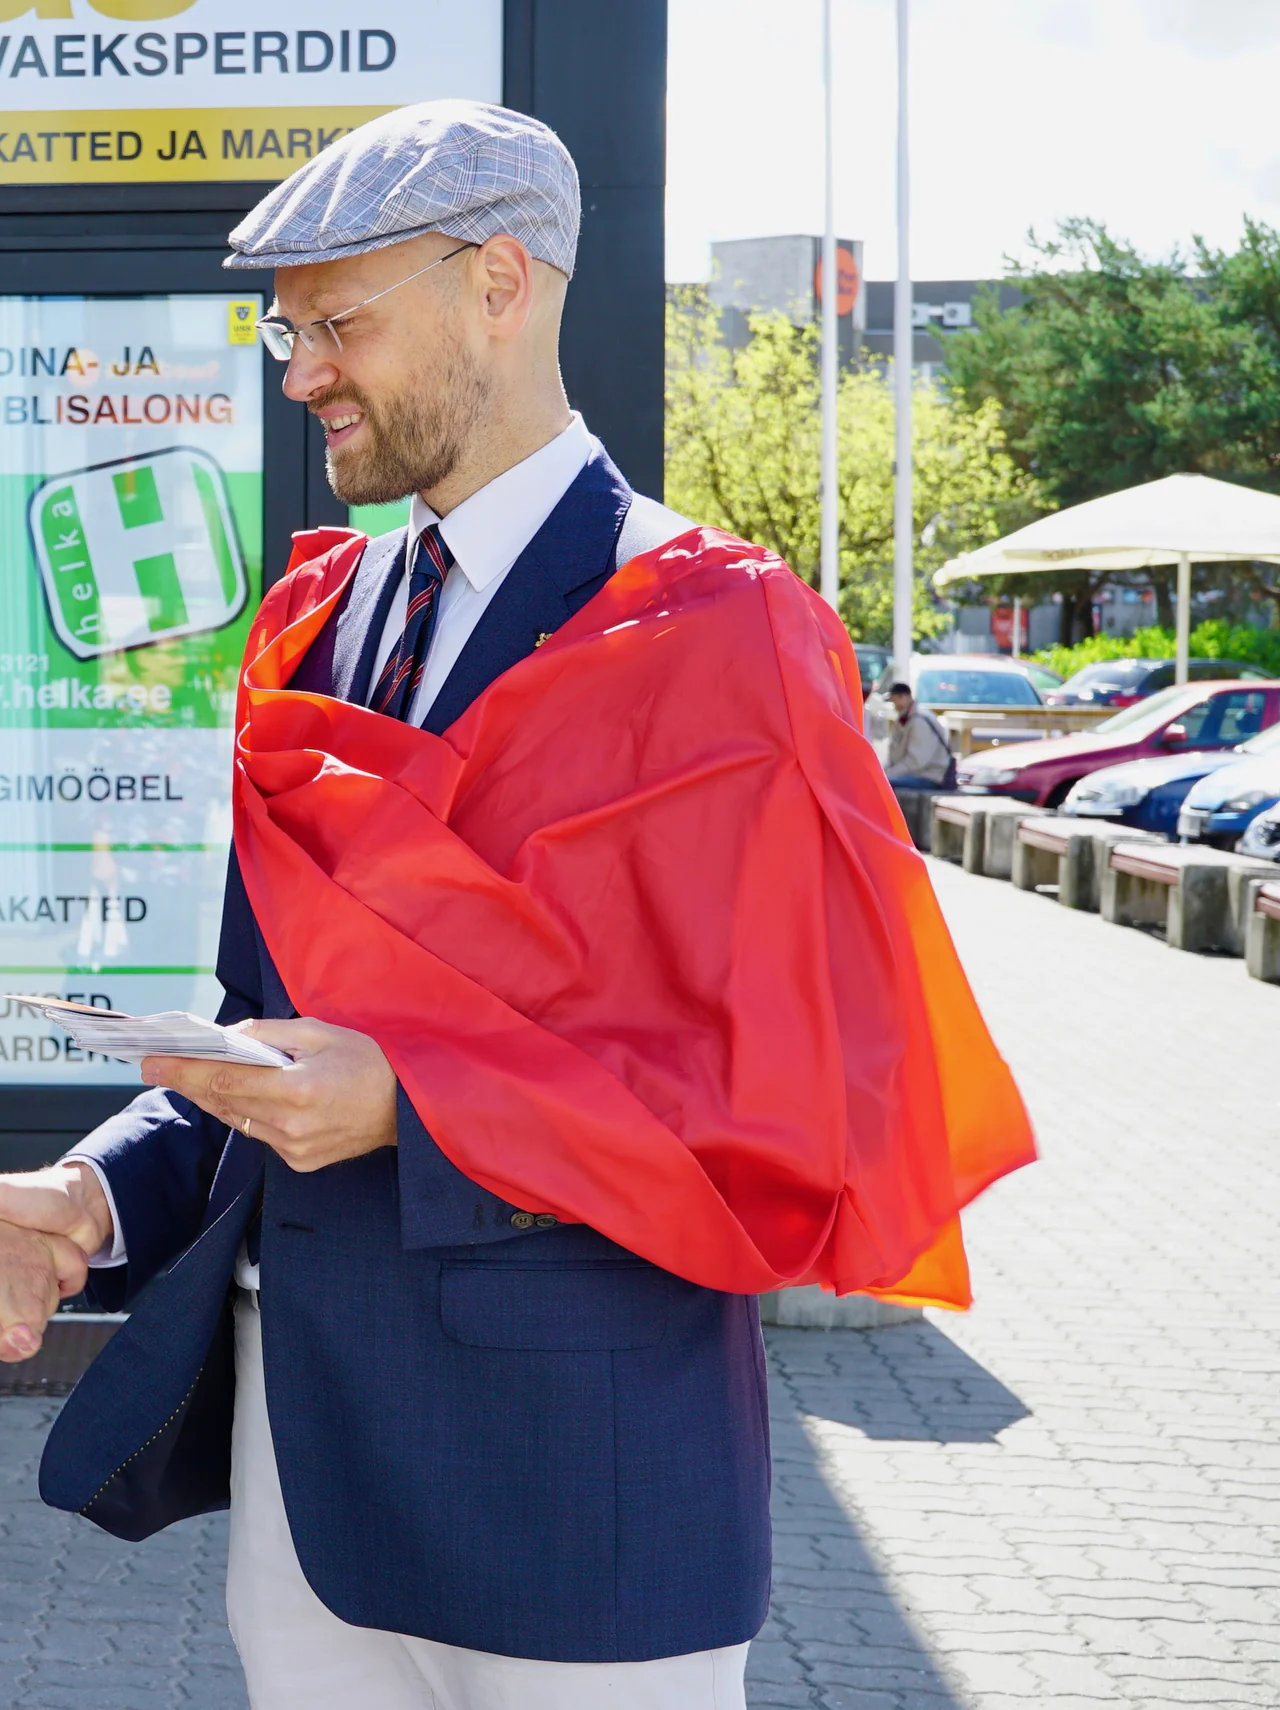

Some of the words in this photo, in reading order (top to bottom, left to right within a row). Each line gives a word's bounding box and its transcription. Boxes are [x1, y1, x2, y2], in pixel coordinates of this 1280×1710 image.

[157, 130, 207, 161] JA
[223, 127, 356, 159] MARK
[111, 346, 160, 376] JA
[51, 500, 102, 636] helka
[0, 653, 50, 672] 3121
